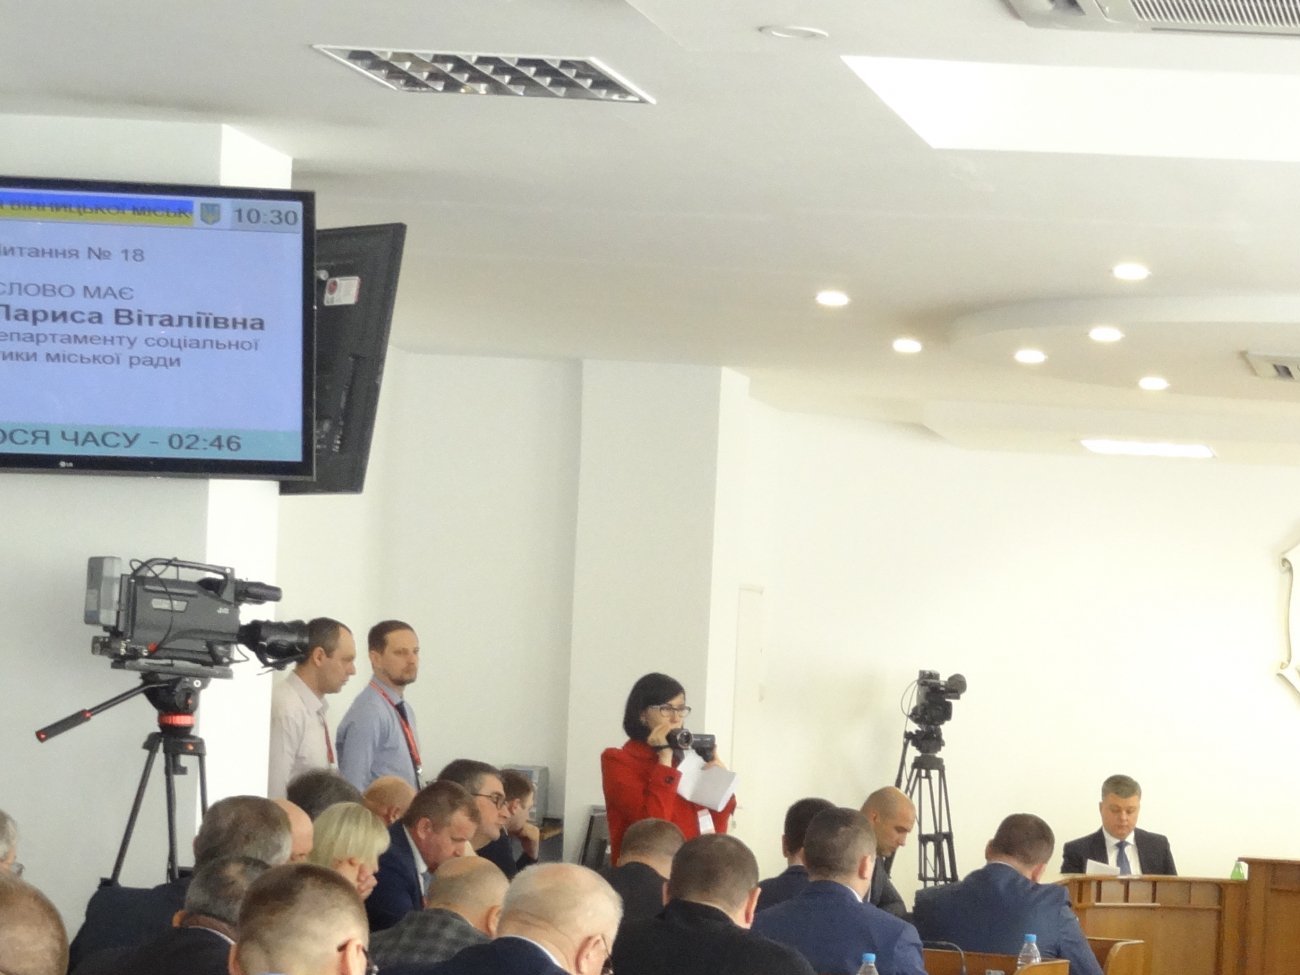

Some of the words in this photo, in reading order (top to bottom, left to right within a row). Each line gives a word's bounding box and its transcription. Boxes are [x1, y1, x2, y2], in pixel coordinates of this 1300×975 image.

[233, 207, 299, 226] 10:30
[0, 244, 80, 259] итання
[87, 246, 112, 261] №
[121, 248, 145, 263] 18
[83, 286, 135, 300] МАЄ
[114, 307, 266, 331] Віталіївна
[144, 335, 260, 352] соціальної
[45, 350, 121, 366] міської
[128, 355, 181, 369] ради
[61, 430, 140, 448] ЧАСУ
[168, 432, 242, 452] 02:46
